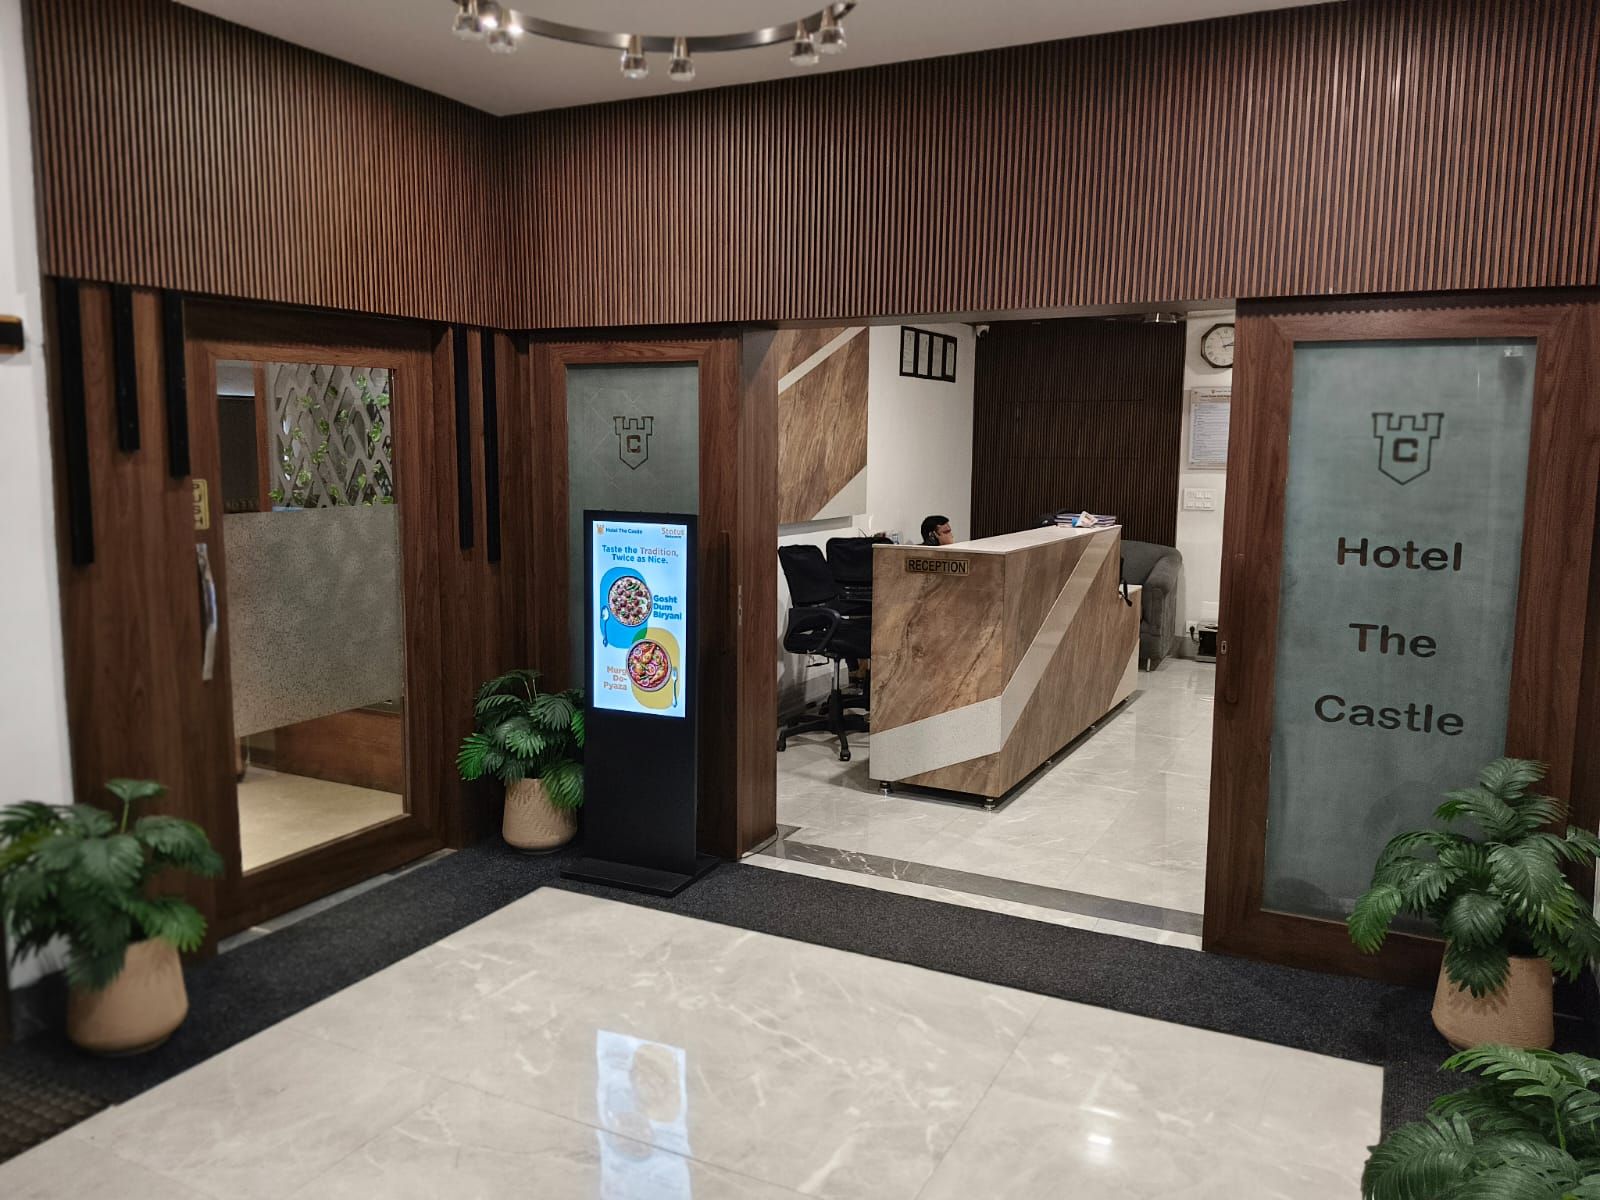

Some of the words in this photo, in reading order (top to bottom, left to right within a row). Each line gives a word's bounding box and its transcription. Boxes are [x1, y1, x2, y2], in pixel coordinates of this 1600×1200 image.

[626, 435, 641, 453] C
[1392, 437, 1419, 463] C
[602, 544, 623, 553] Taste
[625, 545, 638, 554] the
[640, 547, 678, 557] Tradition,
[1336, 536, 1463, 571] Hotel
[612, 554, 635, 562] Twice
[648, 555, 669, 564] Nice.
[908, 559, 966, 573] RECEPTION
[653, 595, 677, 603] Gosht
[653, 603, 672, 611] Dum
[653, 611, 682, 620] Biryani
[1349, 622, 1437, 658] The
[1314, 694, 1465, 736] Castle
